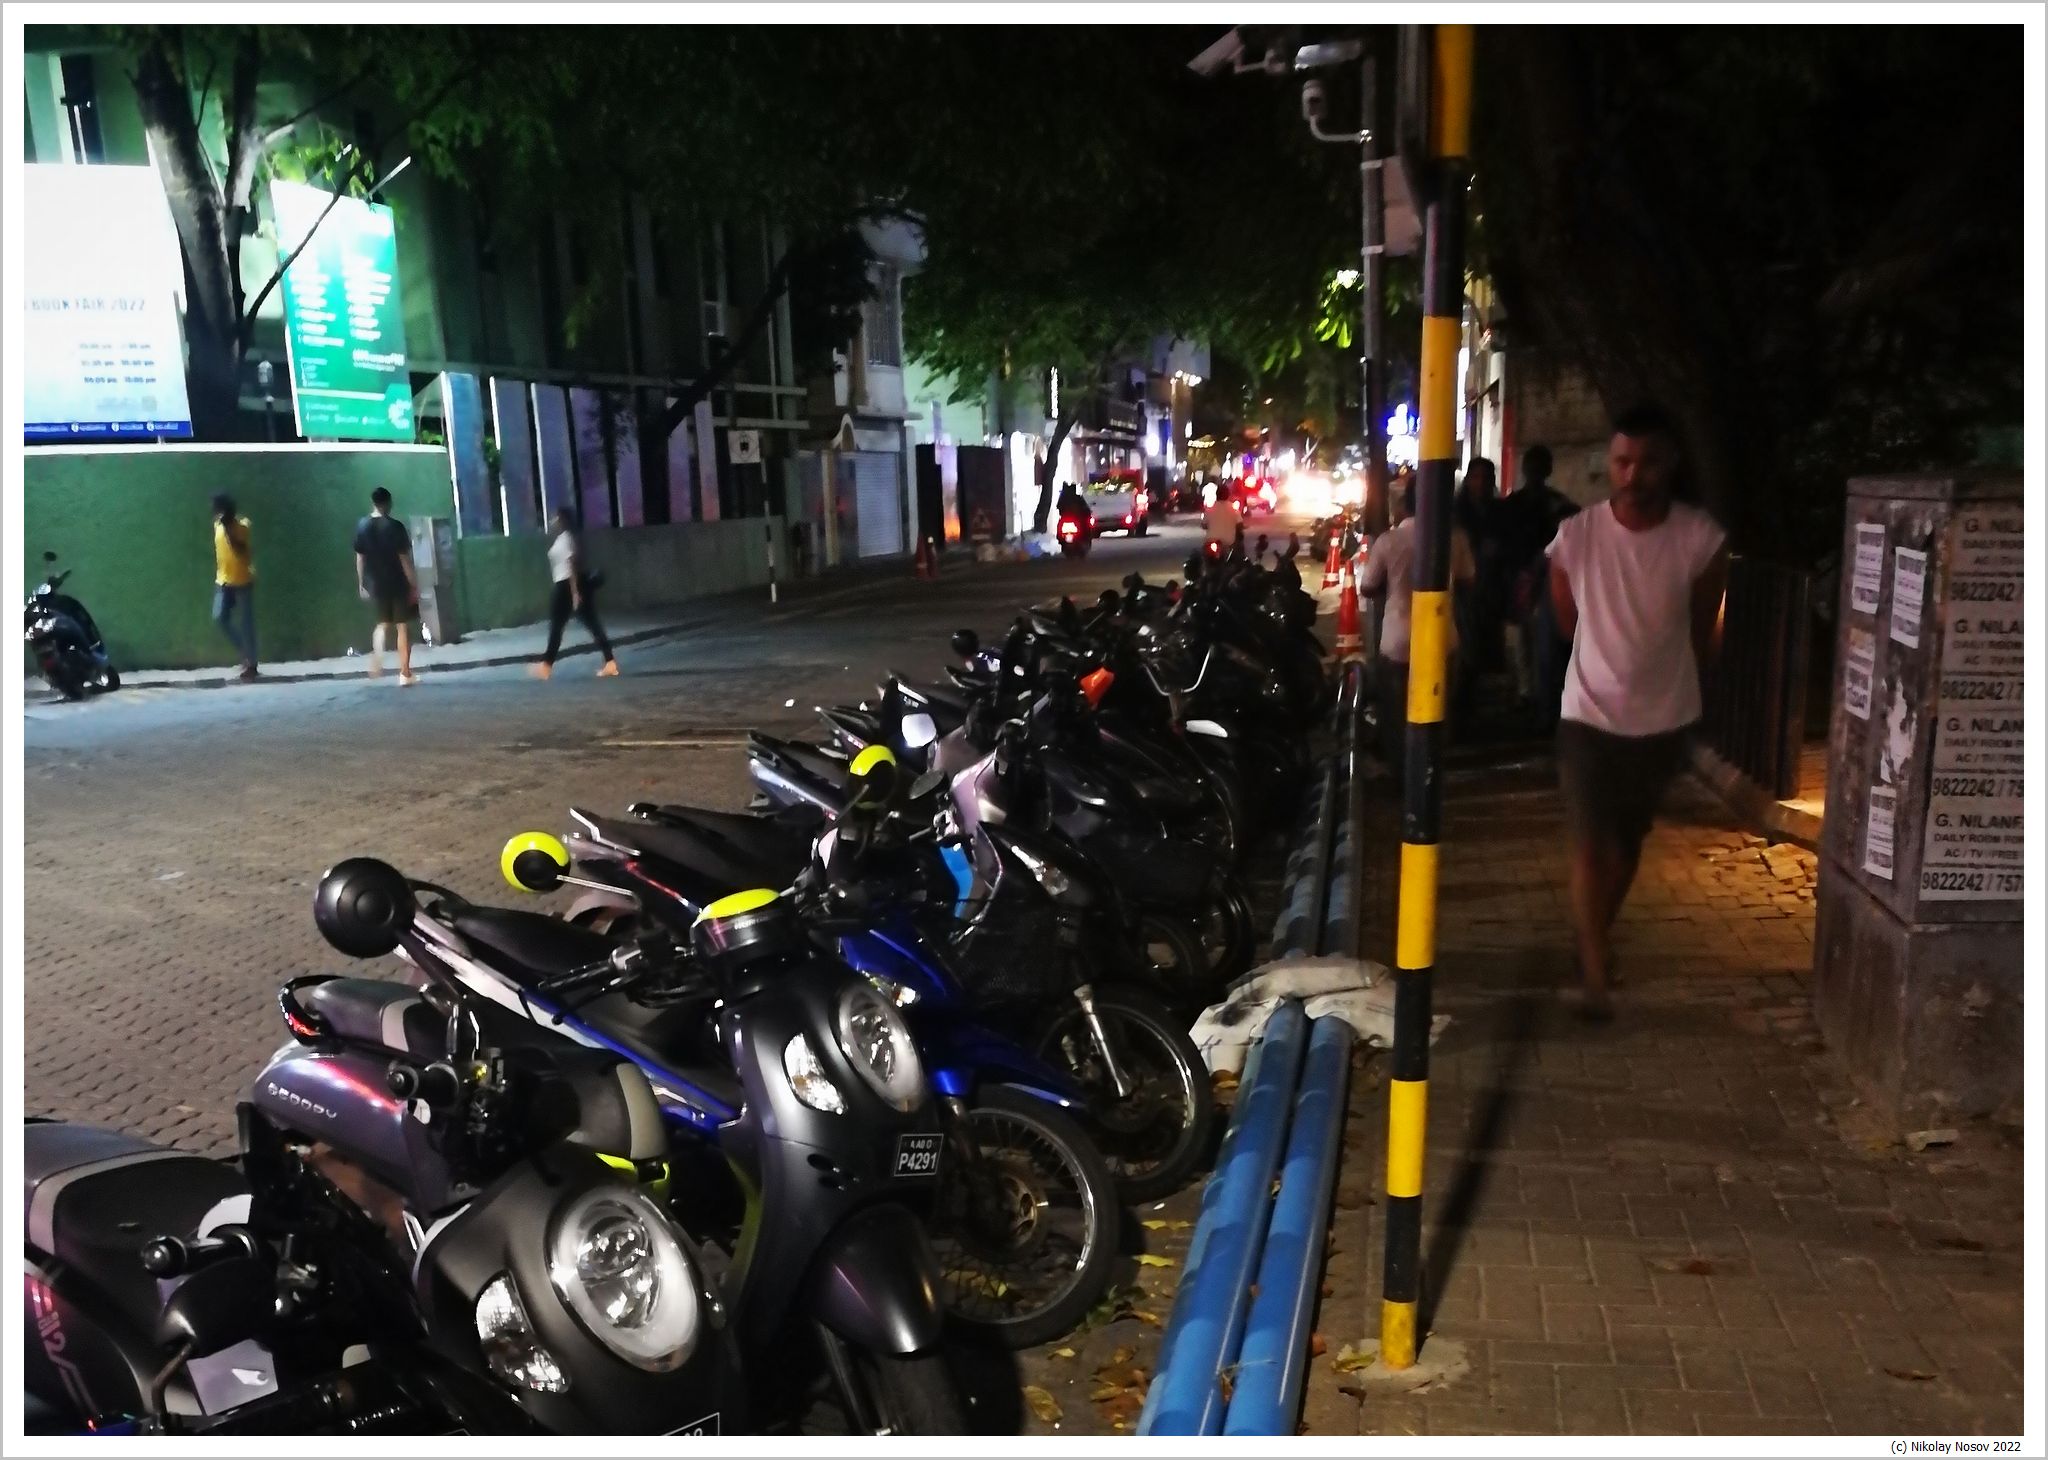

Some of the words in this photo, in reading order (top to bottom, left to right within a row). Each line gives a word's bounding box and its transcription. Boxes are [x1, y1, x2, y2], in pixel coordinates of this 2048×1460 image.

[1950, 582, 2015, 602] 9822242
[1941, 680, 2004, 700] 9822242
[1932, 777, 1995, 797] 9822242
[1935, 813, 1953, 827] G.
[1959, 813, 2024, 828] NILANF
[1934, 833, 1966, 842] DAILY
[1944, 848, 1960, 858] AC
[1970, 849, 1984, 858] TV
[1921, 872, 1984, 891] 9822242
[898, 1151, 938, 1171] P4291
